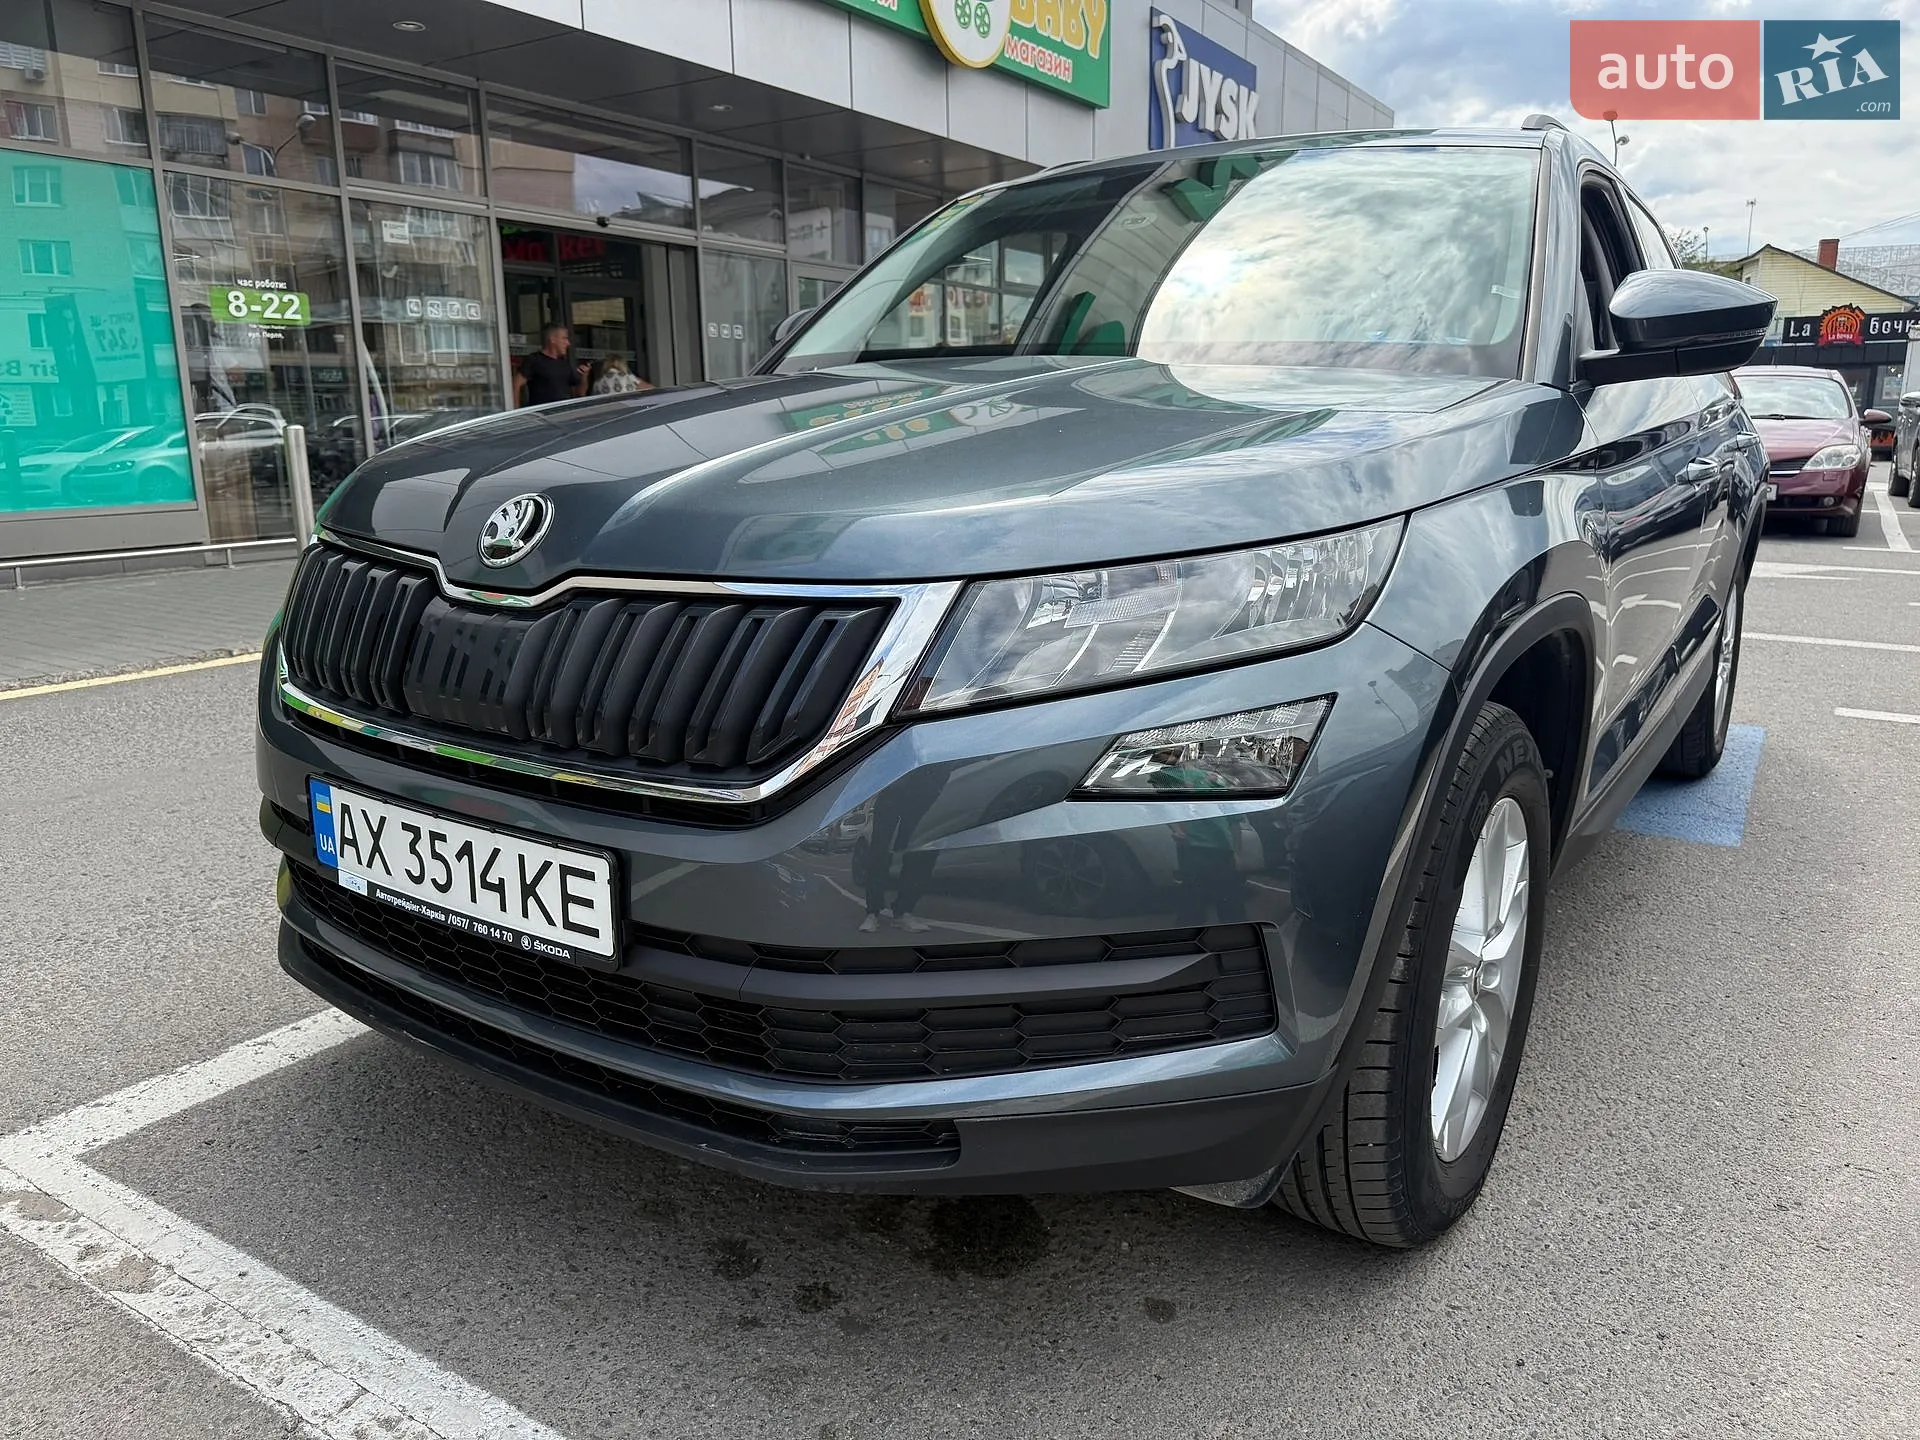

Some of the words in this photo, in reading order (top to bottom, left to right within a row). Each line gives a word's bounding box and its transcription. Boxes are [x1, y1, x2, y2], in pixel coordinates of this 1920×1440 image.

[1178, 58, 1259, 140] JYSK
[227, 290, 302, 319] 8-22
[1789, 320, 1811, 337] La
[1869, 316, 1920, 335] бочк
[320, 834, 335, 854] UA
[340, 803, 393, 876] AX
[401, 822, 507, 913] 3514
[518, 853, 600, 938] KE
[473, 922, 488, 935] 760
[490, 927, 500, 939] 14
[502, 931, 512, 943] 70
[534, 940, 571, 959] ŠKODA
